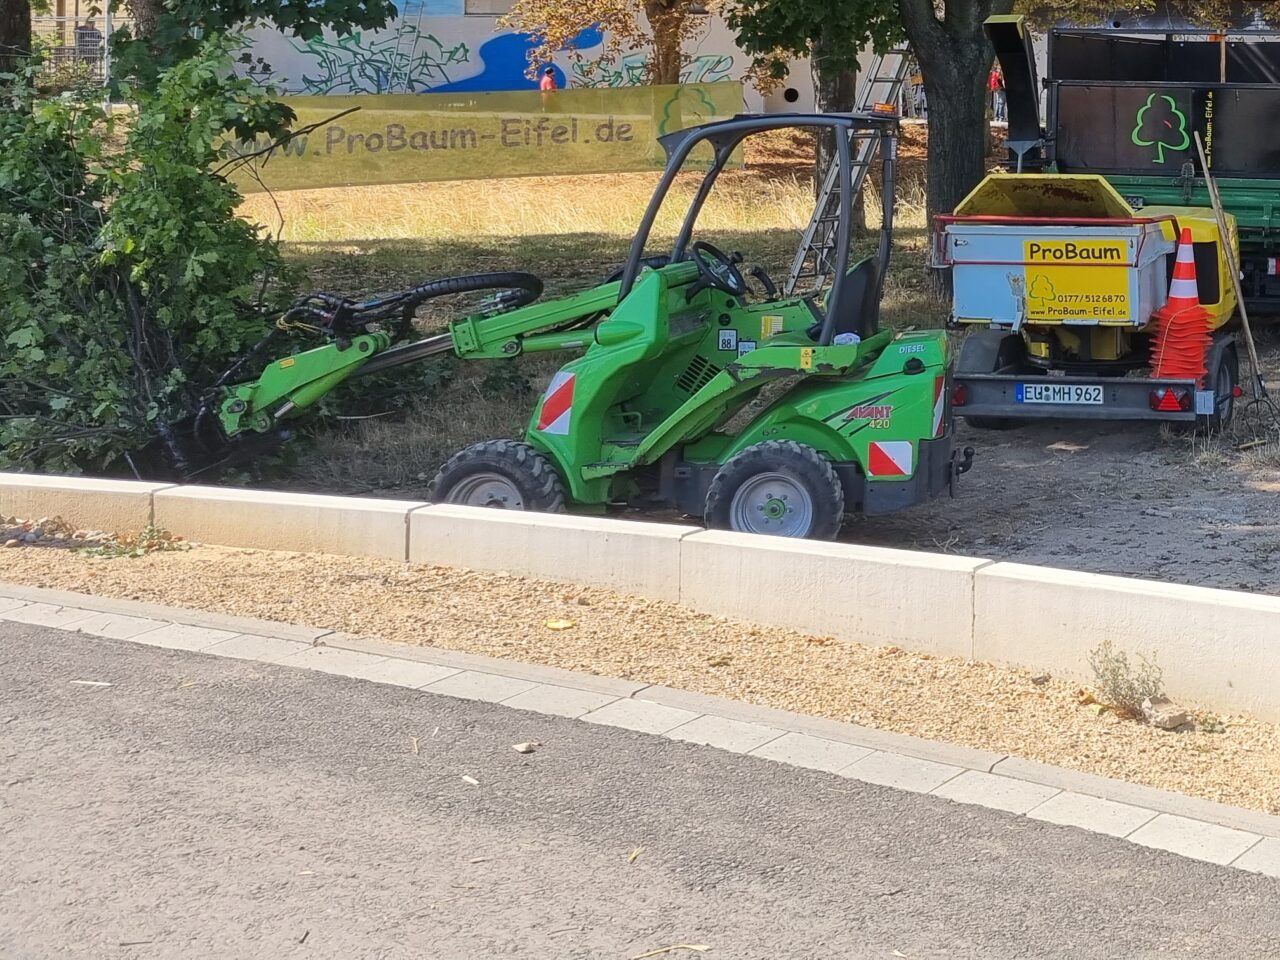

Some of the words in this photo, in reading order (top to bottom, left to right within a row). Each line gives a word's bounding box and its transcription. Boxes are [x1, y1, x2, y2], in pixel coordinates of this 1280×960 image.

[1029, 242, 1121, 260] ProBaum
[721, 338, 732, 349] 88
[899, 344, 925, 354] DIESEL
[1024, 386, 1043, 401] EU
[1052, 386, 1071, 401] MH
[1074, 387, 1102, 402] 962
[846, 406, 893, 419] AVANT
[868, 419, 890, 429] 420
